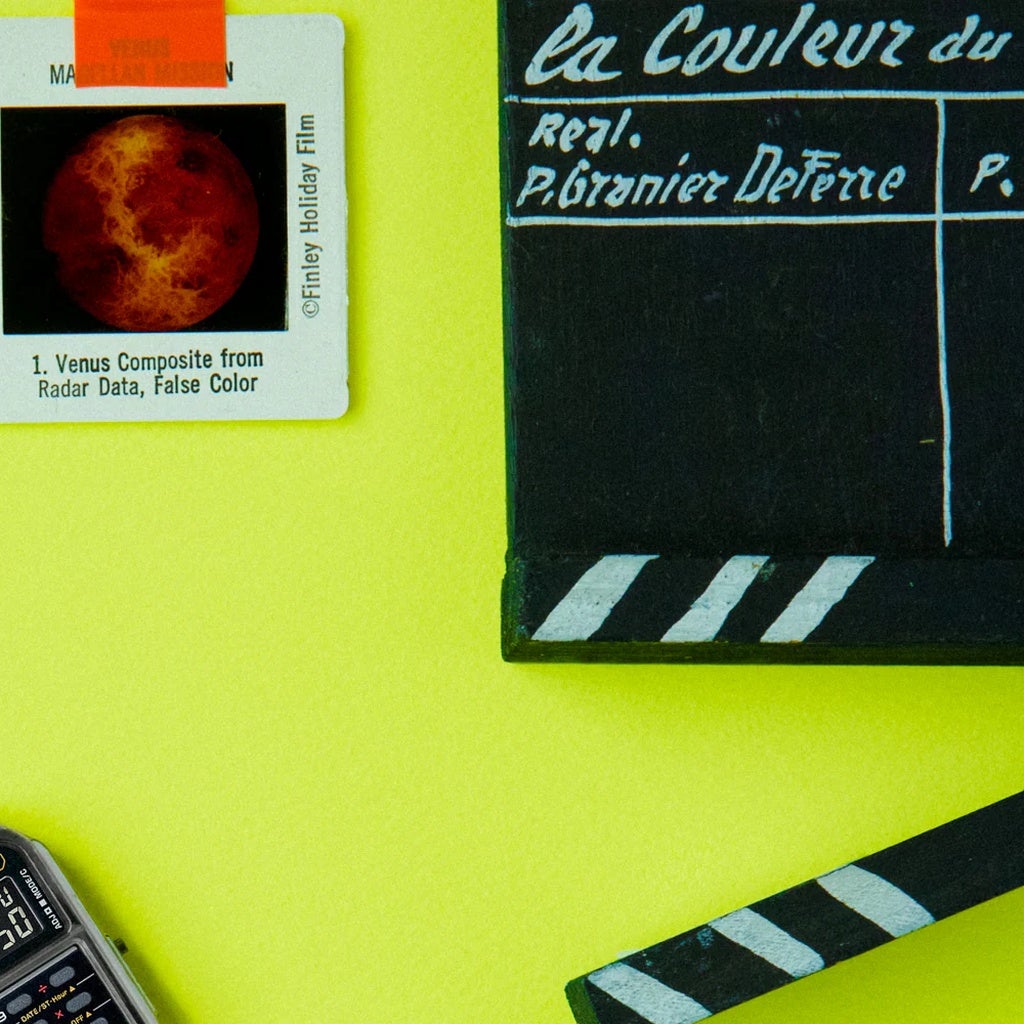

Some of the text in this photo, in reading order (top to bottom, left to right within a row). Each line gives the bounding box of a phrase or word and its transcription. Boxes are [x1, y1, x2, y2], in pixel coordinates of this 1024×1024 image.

[643, 3, 915, 78] Couleur
[928, 14, 1013, 64] du
[296, 114, 315, 155] Film
[970, 153, 1014, 198] P.
[298, 163, 320, 234] Holiday
[32, 348, 263, 375] 1. Venus Composite from
[38, 372, 258, 399] Radar Data, False Color
[19, 868, 63, 930] MODE/C ADJ
